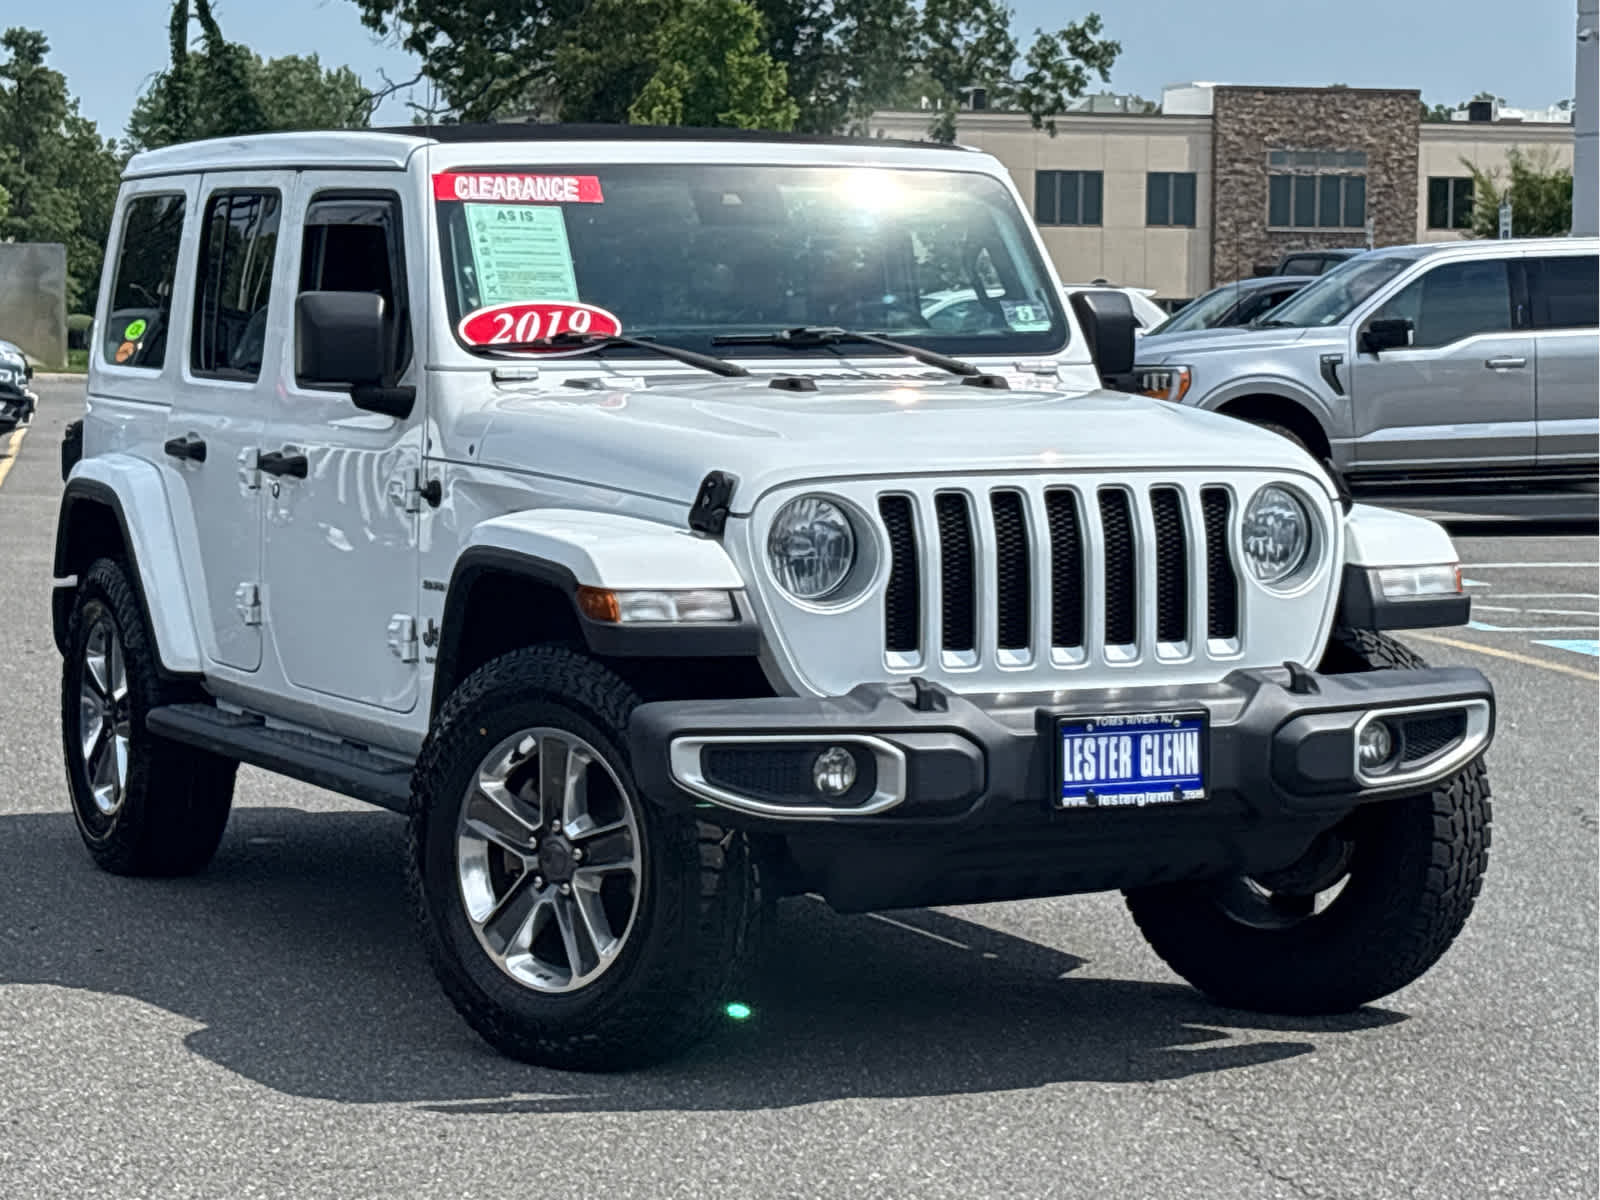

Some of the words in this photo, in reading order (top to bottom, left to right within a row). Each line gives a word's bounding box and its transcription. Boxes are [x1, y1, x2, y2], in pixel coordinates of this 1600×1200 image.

[454, 176, 580, 200] CLEARANCE
[496, 210, 516, 222] AS
[520, 211, 535, 222] IS
[488, 310, 592, 344] 2019
[1064, 735, 1133, 782] LESTER
[1140, 732, 1199, 778] GLENN
